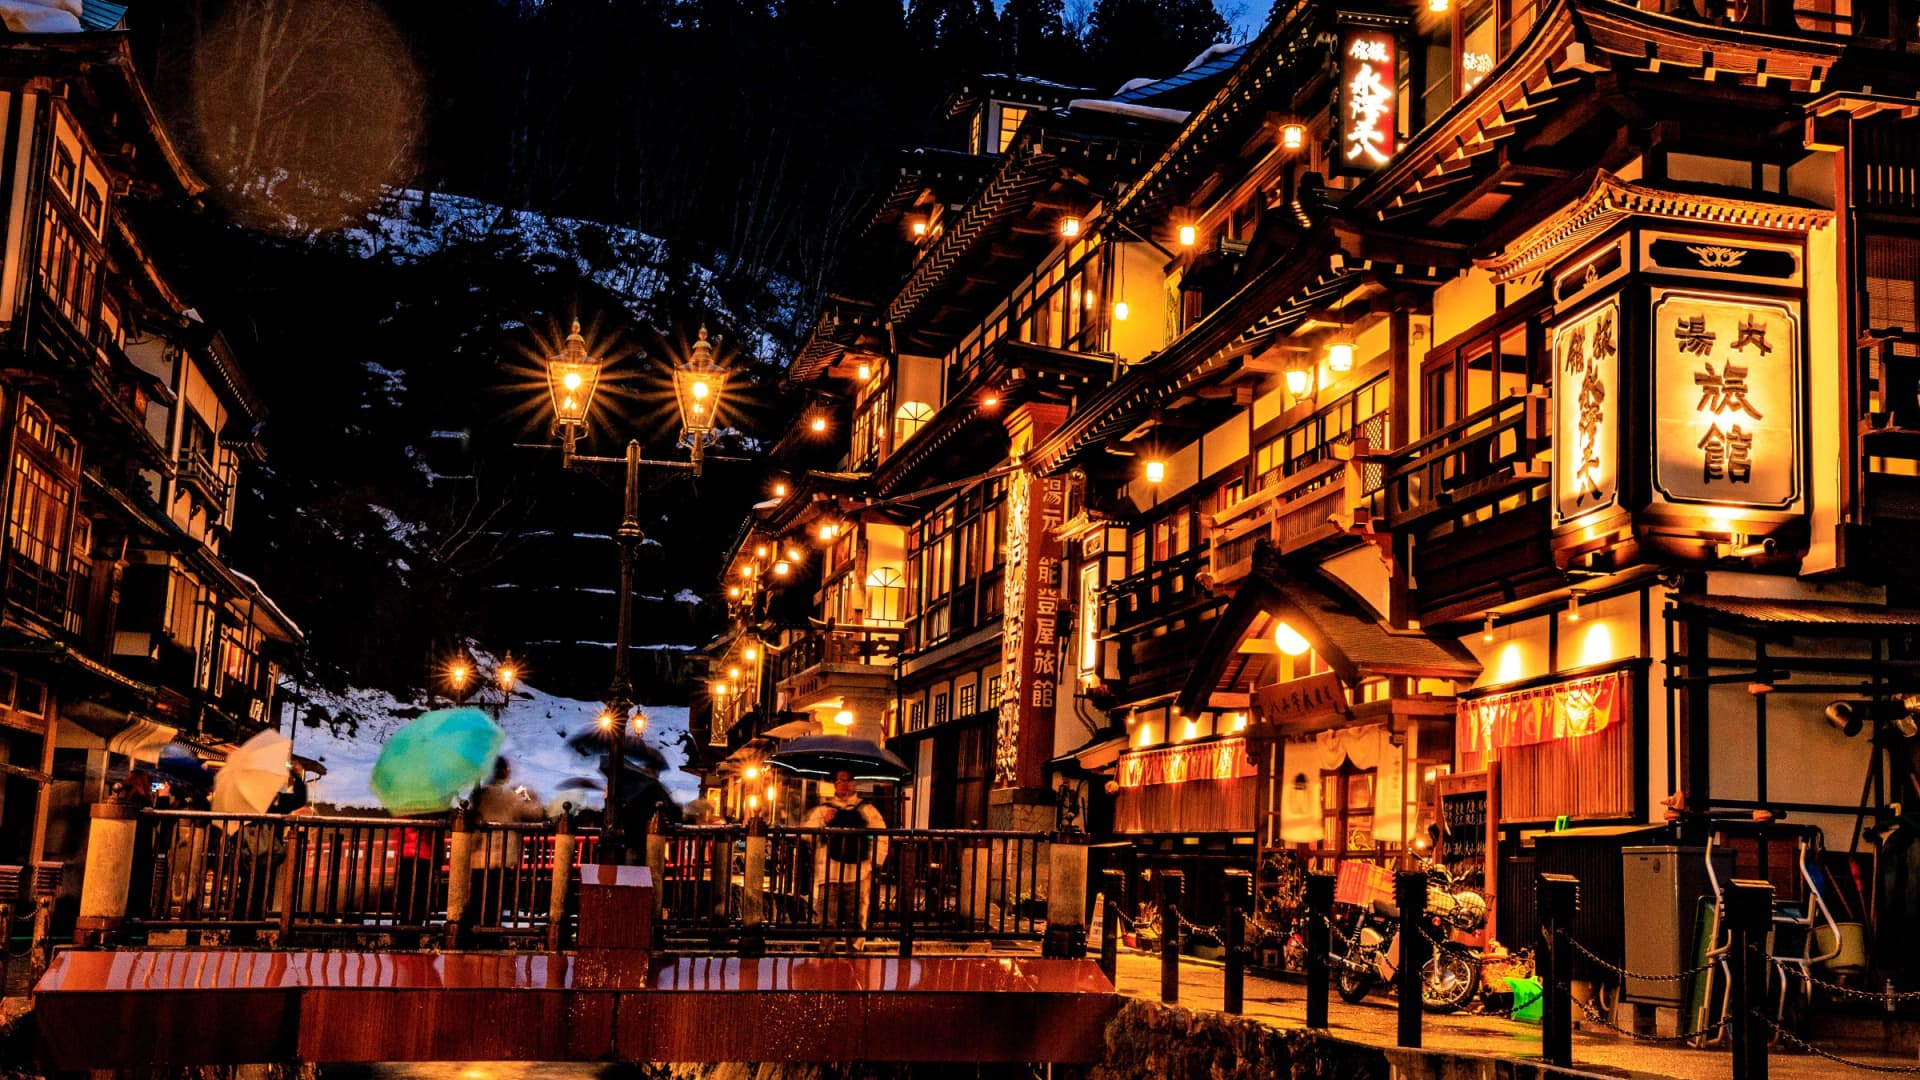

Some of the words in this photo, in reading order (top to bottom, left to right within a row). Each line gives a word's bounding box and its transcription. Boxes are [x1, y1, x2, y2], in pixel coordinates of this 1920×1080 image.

[1694, 360, 1764, 484] 旅館
[1041, 478, 1064, 534] 湯元
[1031, 556, 1060, 709] 能登屋旅館
